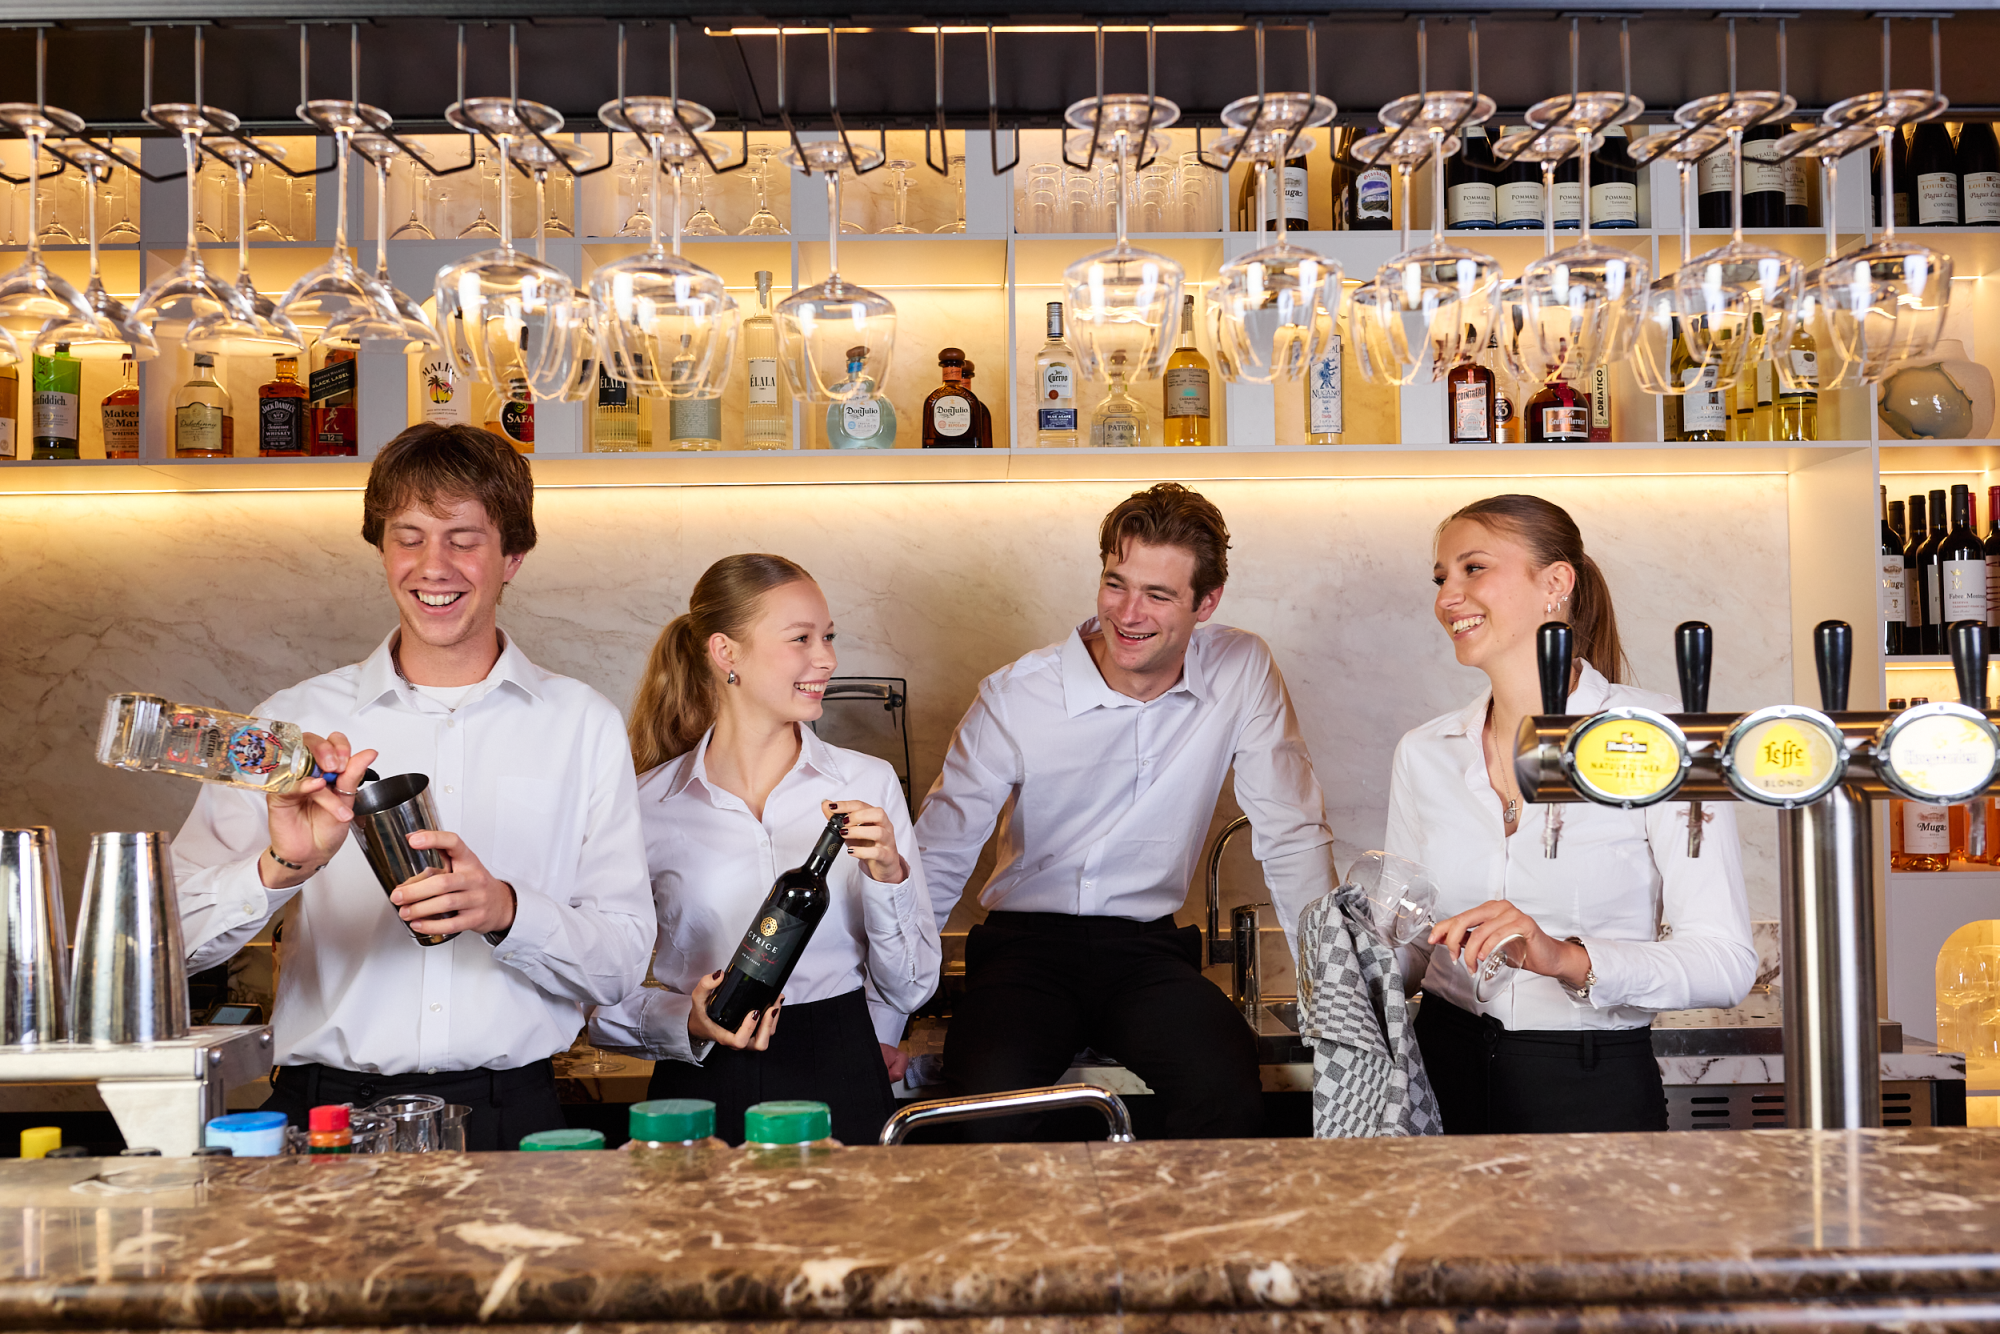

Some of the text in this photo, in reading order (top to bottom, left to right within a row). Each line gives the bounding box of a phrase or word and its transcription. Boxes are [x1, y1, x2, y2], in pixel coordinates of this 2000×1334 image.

[1456, 387, 1486, 401] COINTREAU
[1596, 369, 1604, 418] ADRIATICO
[1764, 739, 1805, 769] Leffe
[1763, 779, 1805, 788] BLOND
[1916, 822, 1947, 833] Muga
[748, 929, 779, 954] CYRICE
